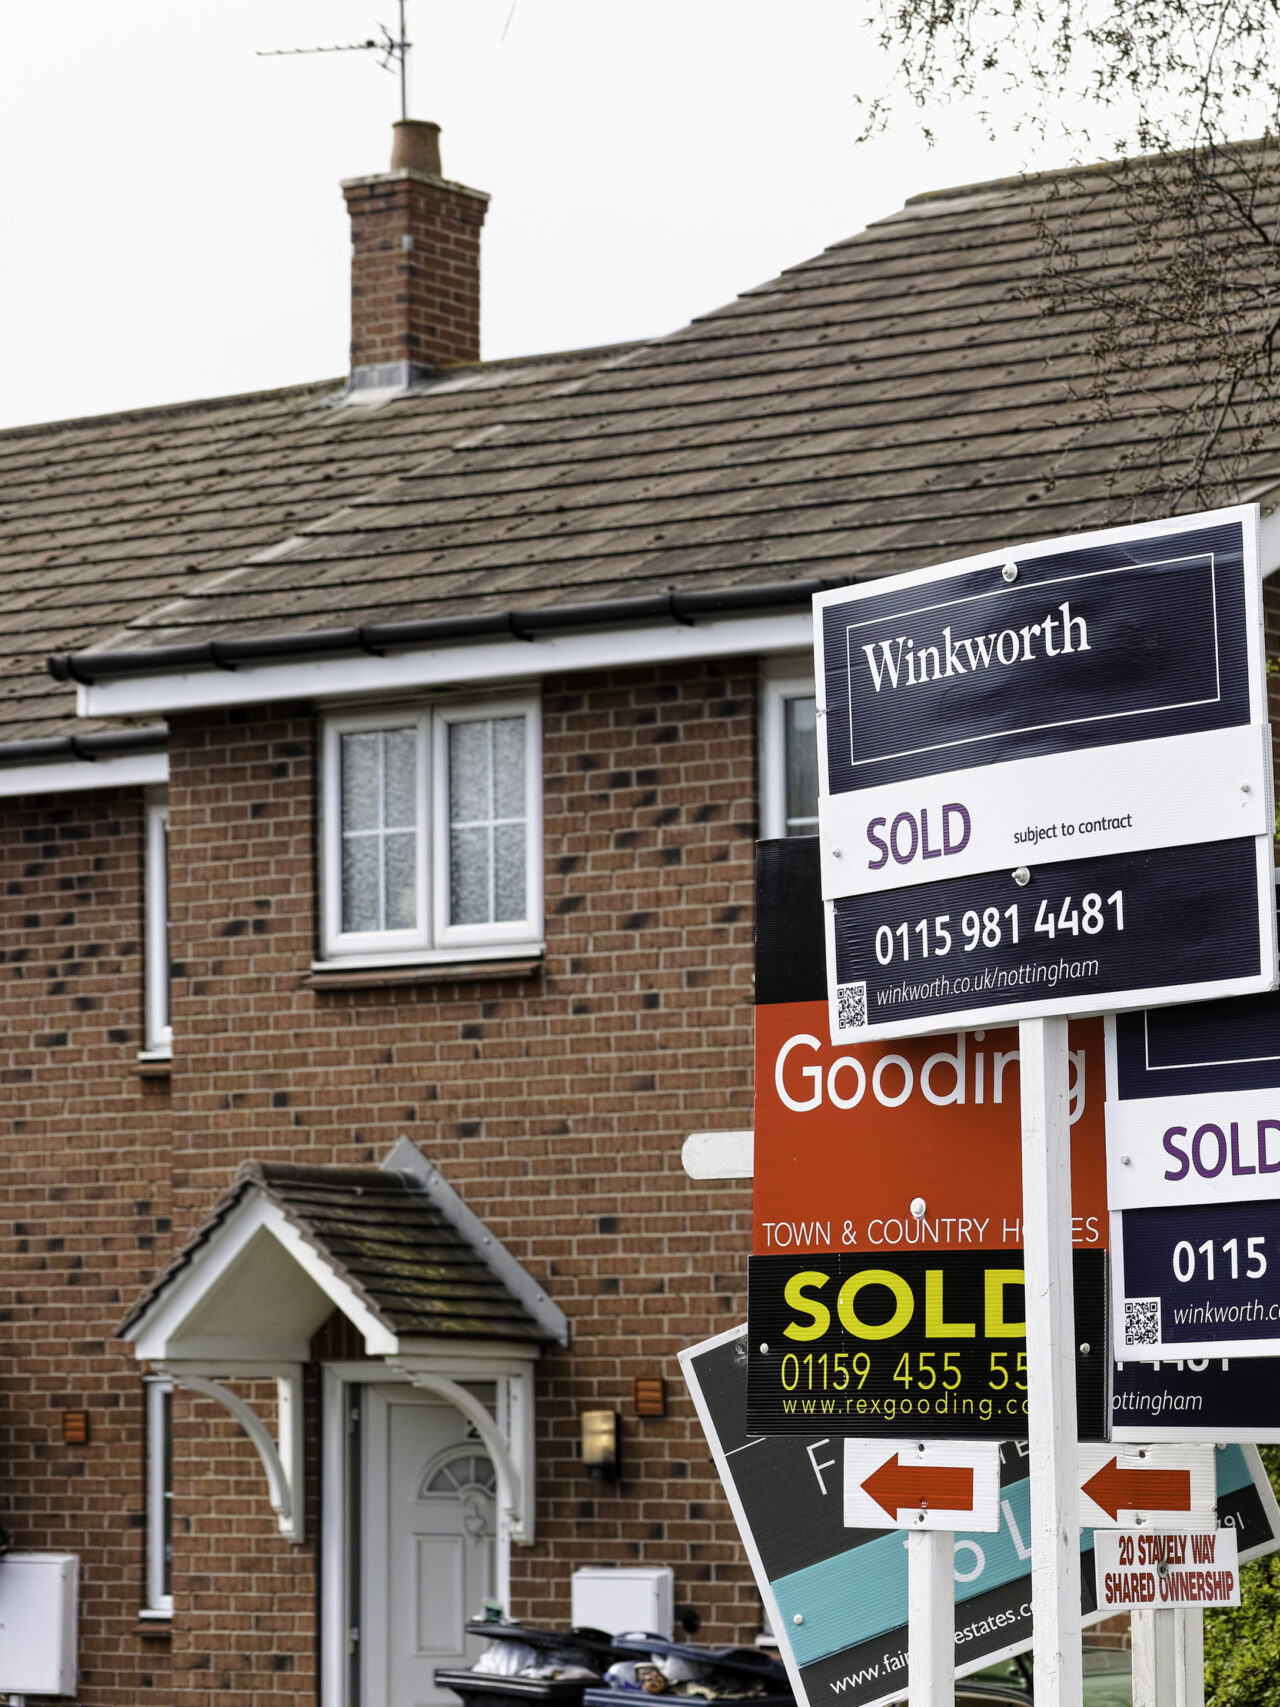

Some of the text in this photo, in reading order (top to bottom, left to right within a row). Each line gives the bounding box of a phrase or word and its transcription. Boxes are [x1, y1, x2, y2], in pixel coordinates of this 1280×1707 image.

[862, 601, 1092, 693] Winkworth
[866, 802, 971, 870] SOLD
[1013, 813, 1133, 846] subject to contract
[875, 890, 1125, 966] 0115 981 4481
[877, 956, 1099, 1007] winkworth.co.uk/nottingham
[775, 1032, 1086, 1126] Goodin
[762, 1216, 1100, 1247] TOWN & COUNTRY HES
[1173, 1234, 1268, 1283] 0115
[783, 1268, 1027, 1342] SOLD
[781, 1352, 871, 1391] 01159
[893, 1352, 961, 1391] 455
[1118, 1534, 1216, 1565] 20 STAVELY WAY
[1105, 1571, 1234, 1603] SHARED OWNERSHIP
